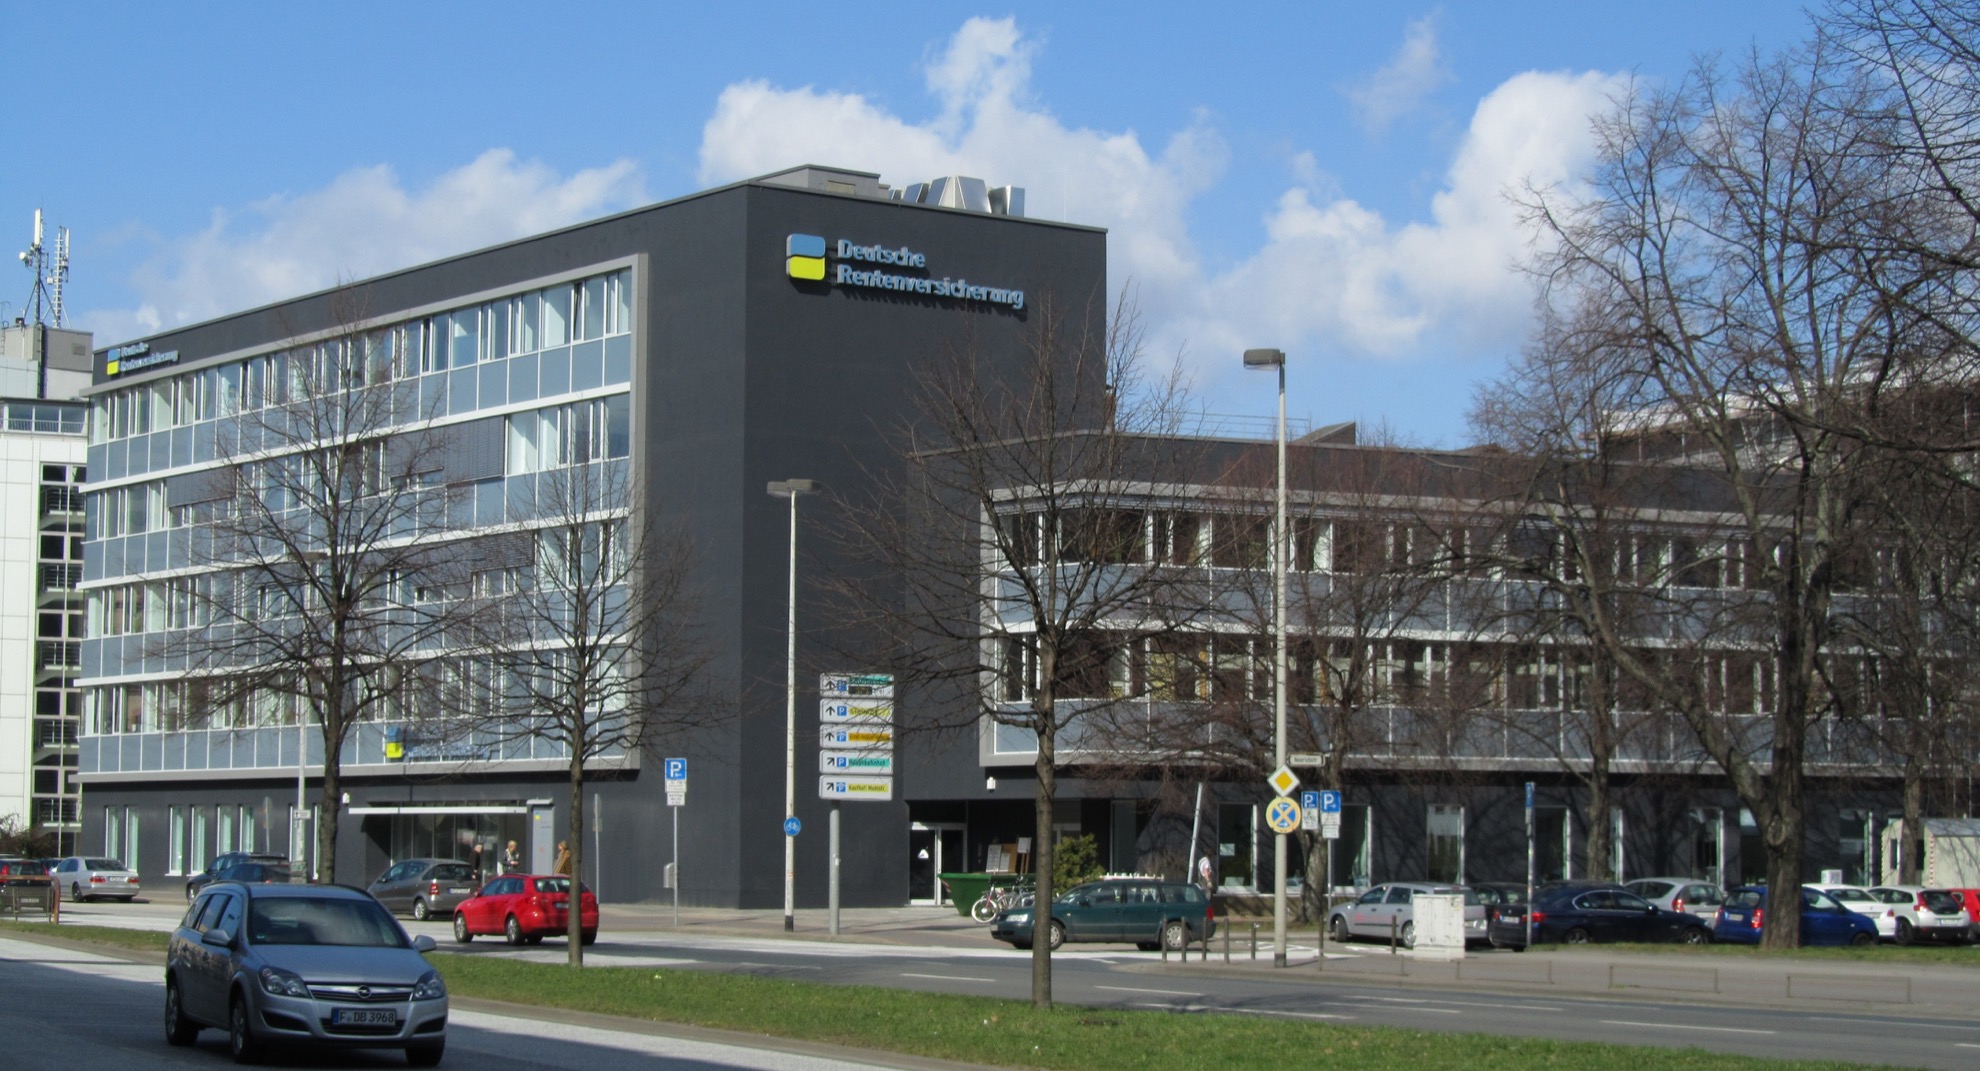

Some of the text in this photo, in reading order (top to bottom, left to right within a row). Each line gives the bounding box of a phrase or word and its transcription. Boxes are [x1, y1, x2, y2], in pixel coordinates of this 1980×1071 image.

[837, 239, 926, 268] Deutsche
[837, 263, 1024, 310] Rentenversicherung
[670, 761, 682, 778] P
[1304, 794, 1314, 808] P
[1323, 793, 1334, 811] P
[340, 1011, 347, 1022] F
[369, 1012, 395, 1023] 3968
